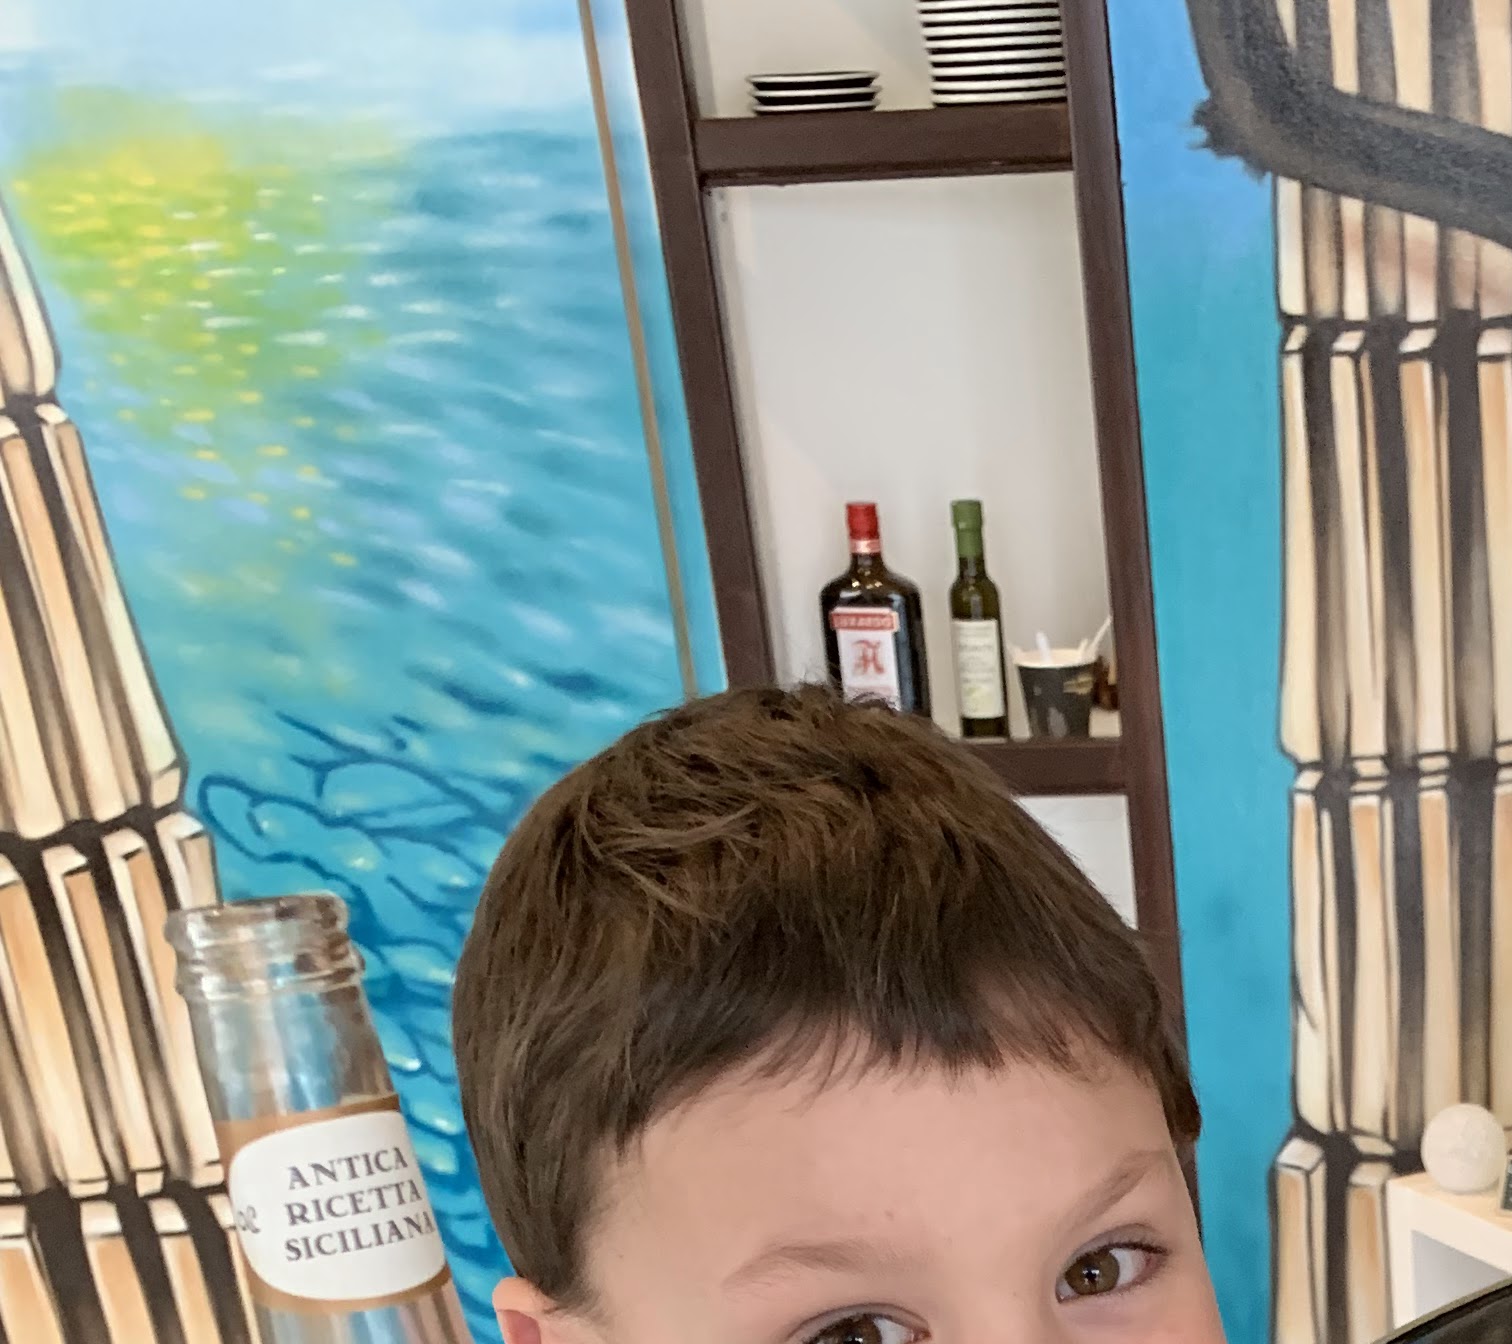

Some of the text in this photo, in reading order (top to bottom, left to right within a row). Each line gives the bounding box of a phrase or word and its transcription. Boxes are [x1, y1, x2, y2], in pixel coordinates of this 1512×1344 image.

[287, 1147, 408, 1190] ANTICA
[284, 1179, 423, 1226] RICETTA
[284, 1211, 436, 1262] SICILIANA
